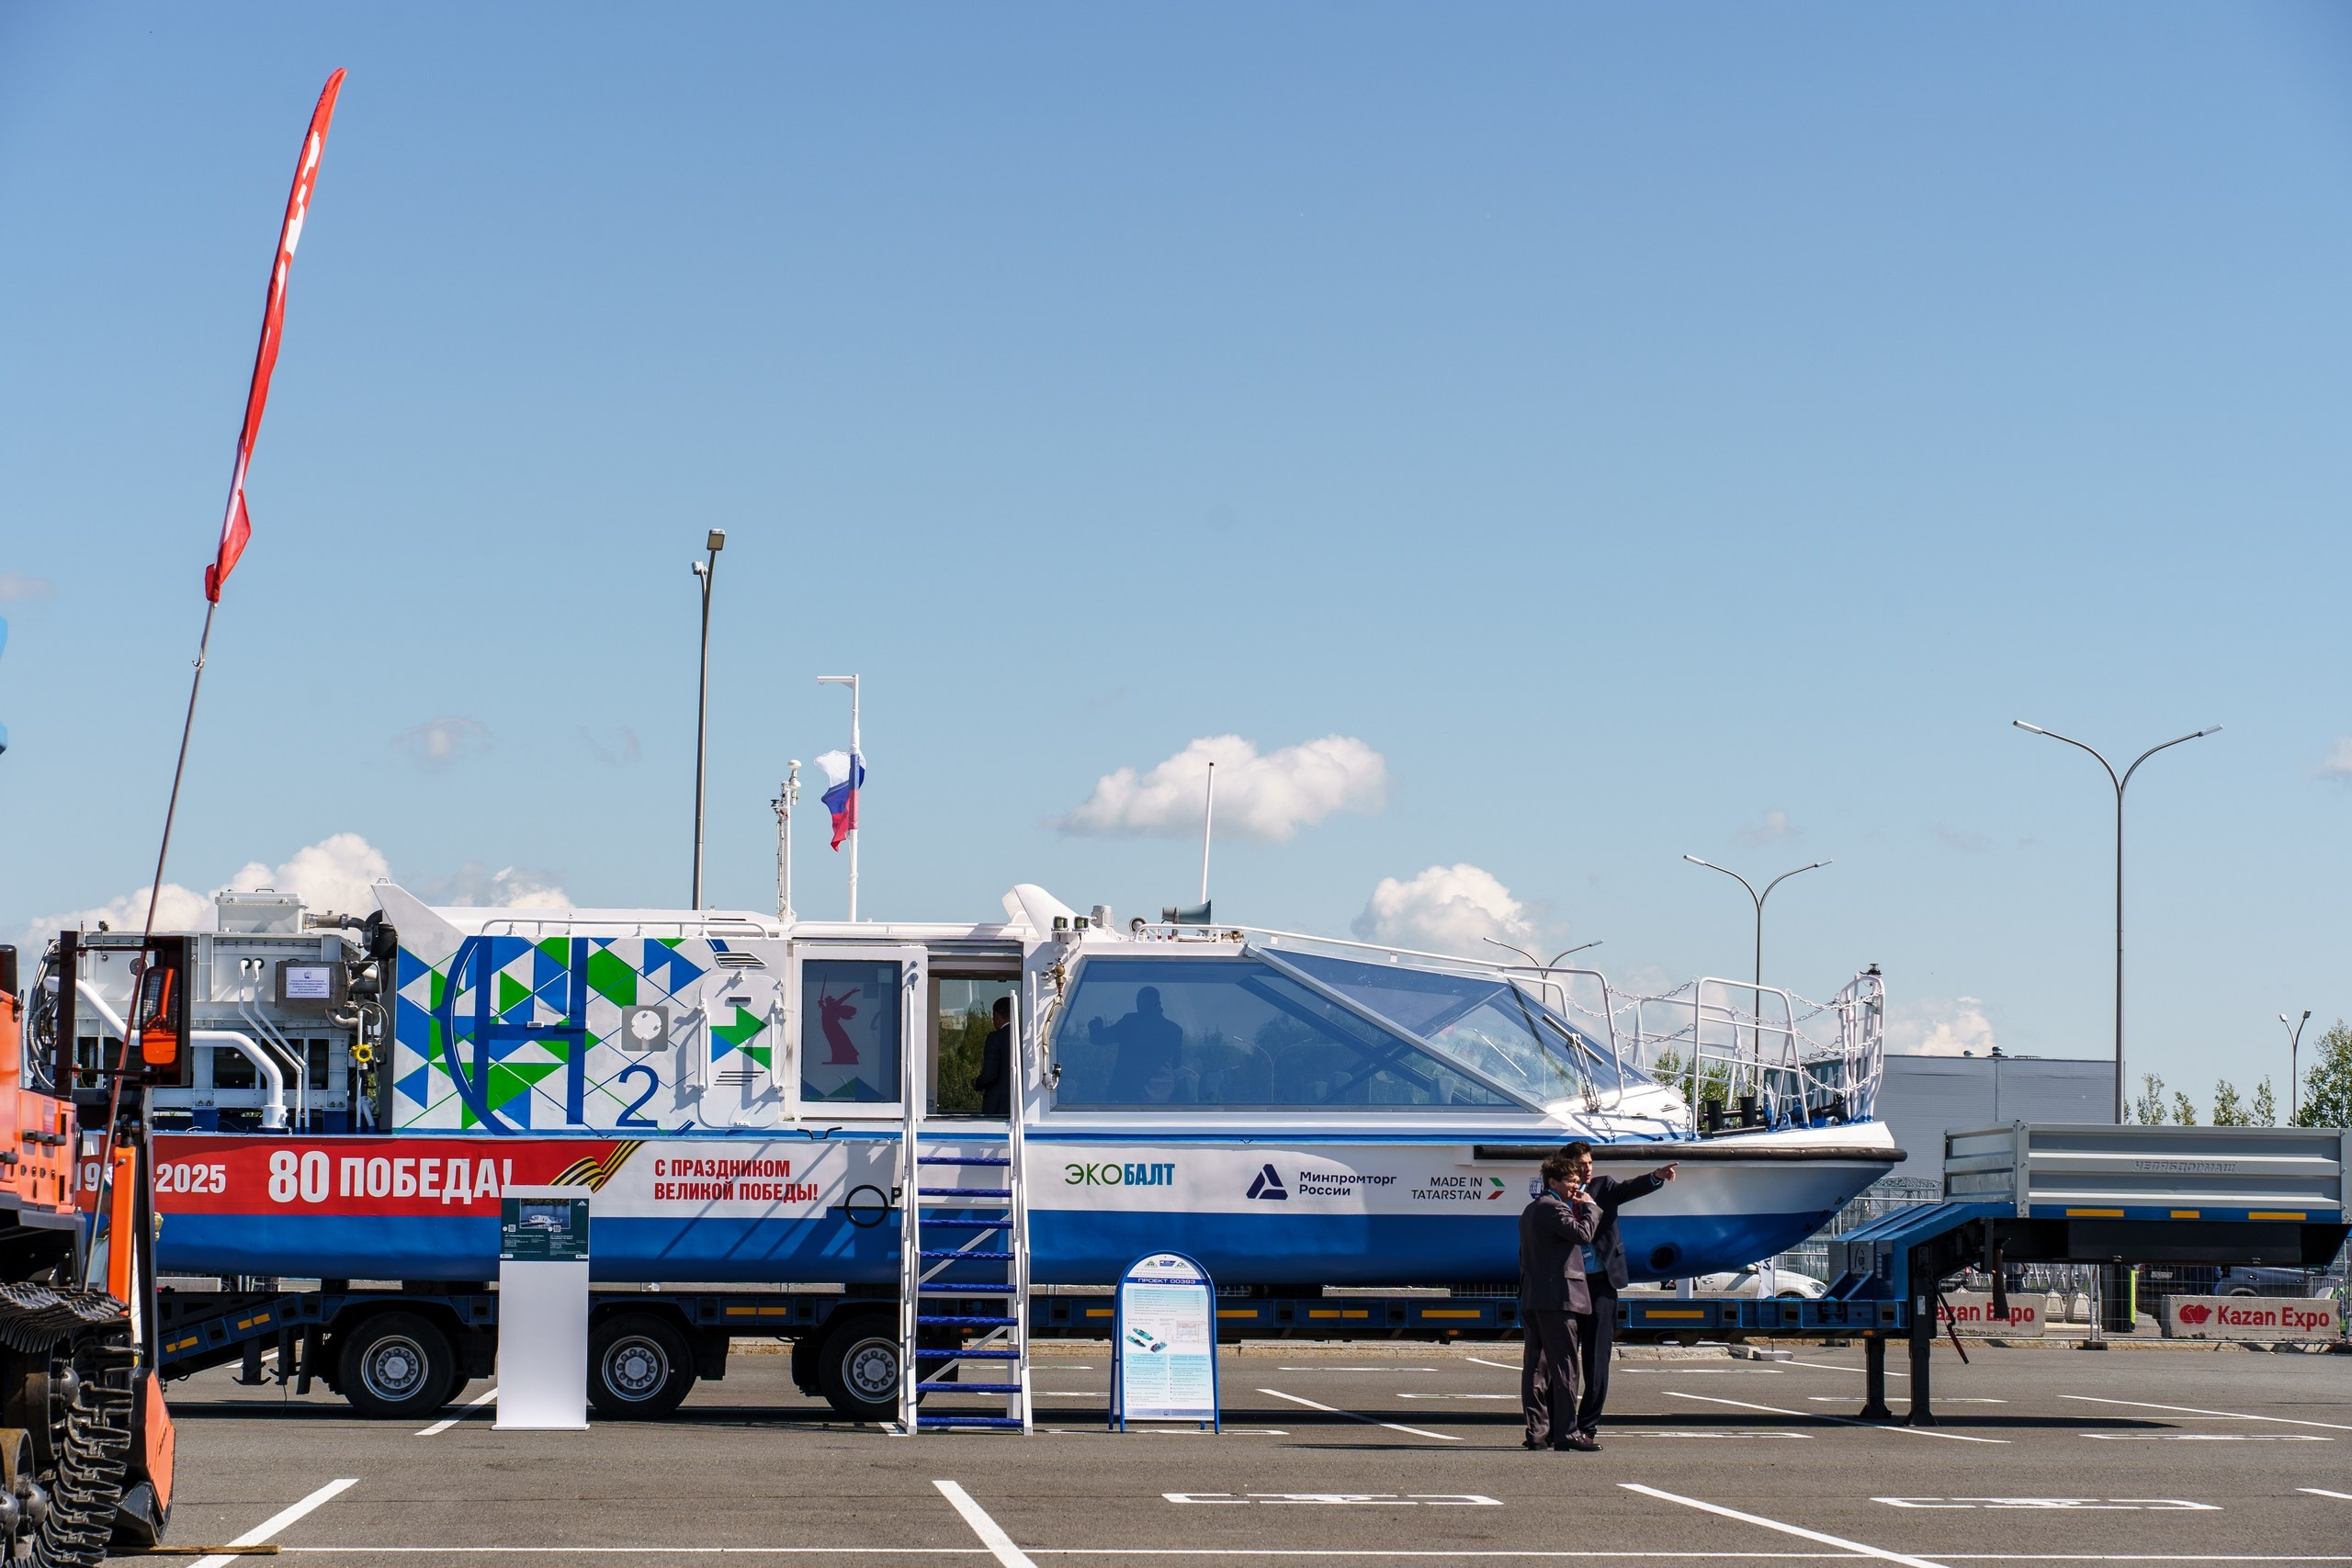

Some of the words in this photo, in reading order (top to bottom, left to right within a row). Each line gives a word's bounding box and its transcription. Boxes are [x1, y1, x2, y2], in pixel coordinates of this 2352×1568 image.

[268, 1150, 330, 1202] 80
[340, 1157, 513, 1204] ПОБЕДА!
[654, 1159, 666, 1177] С
[671, 1159, 791, 1179] ПРАЗДНИКОМ
[1064, 1163, 1176, 1186] ЭКОБАЛТ
[1299, 1171, 1397, 1185] Минпромторг
[654, 1181, 734, 1201] ВЕЛИКОЙ
[739, 1183, 819, 1203] ПОБЕДЫ!
[1298, 1184, 1351, 1196] России
[1430, 1177, 1466, 1188] MADE
[1470, 1177, 1483, 1188] IN
[1411, 1190, 1482, 1200] TATARSTAN
[1935, 1305, 1981, 1321] azan
[1986, 1302, 2035, 1326] Epo
[2217, 1304, 2276, 1325] Kazan
[2281, 1306, 2330, 1331] Expo
